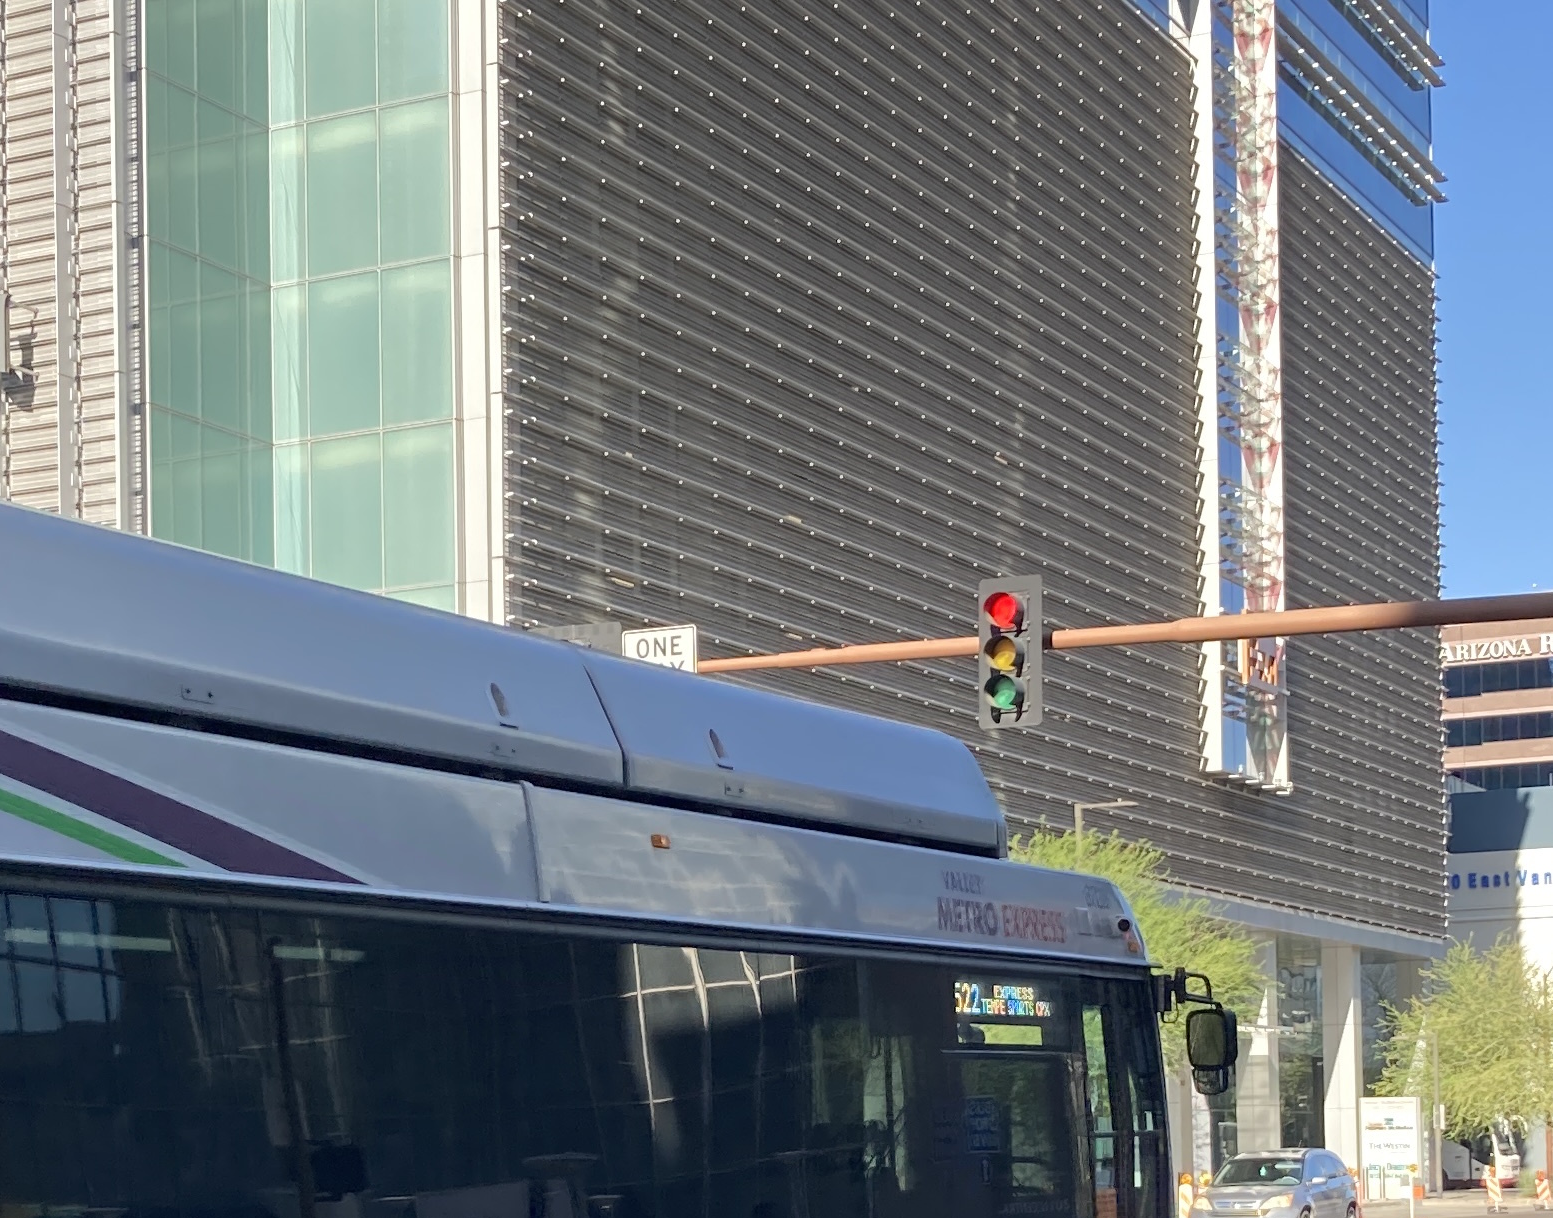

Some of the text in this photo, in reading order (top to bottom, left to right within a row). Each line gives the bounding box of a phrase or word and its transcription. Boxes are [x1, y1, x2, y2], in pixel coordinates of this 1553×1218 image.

[635, 635, 683, 659] ONE
[1439, 637, 1533, 662] ARIZONA
[942, 870, 985, 895] VALLEY
[1468, 871, 1510, 889] East
[1516, 869, 1553, 887] Van
[937, 896, 1066, 943] METRO EXPRESS
[954, 981, 1034, 1013] 522 EXPRESS
